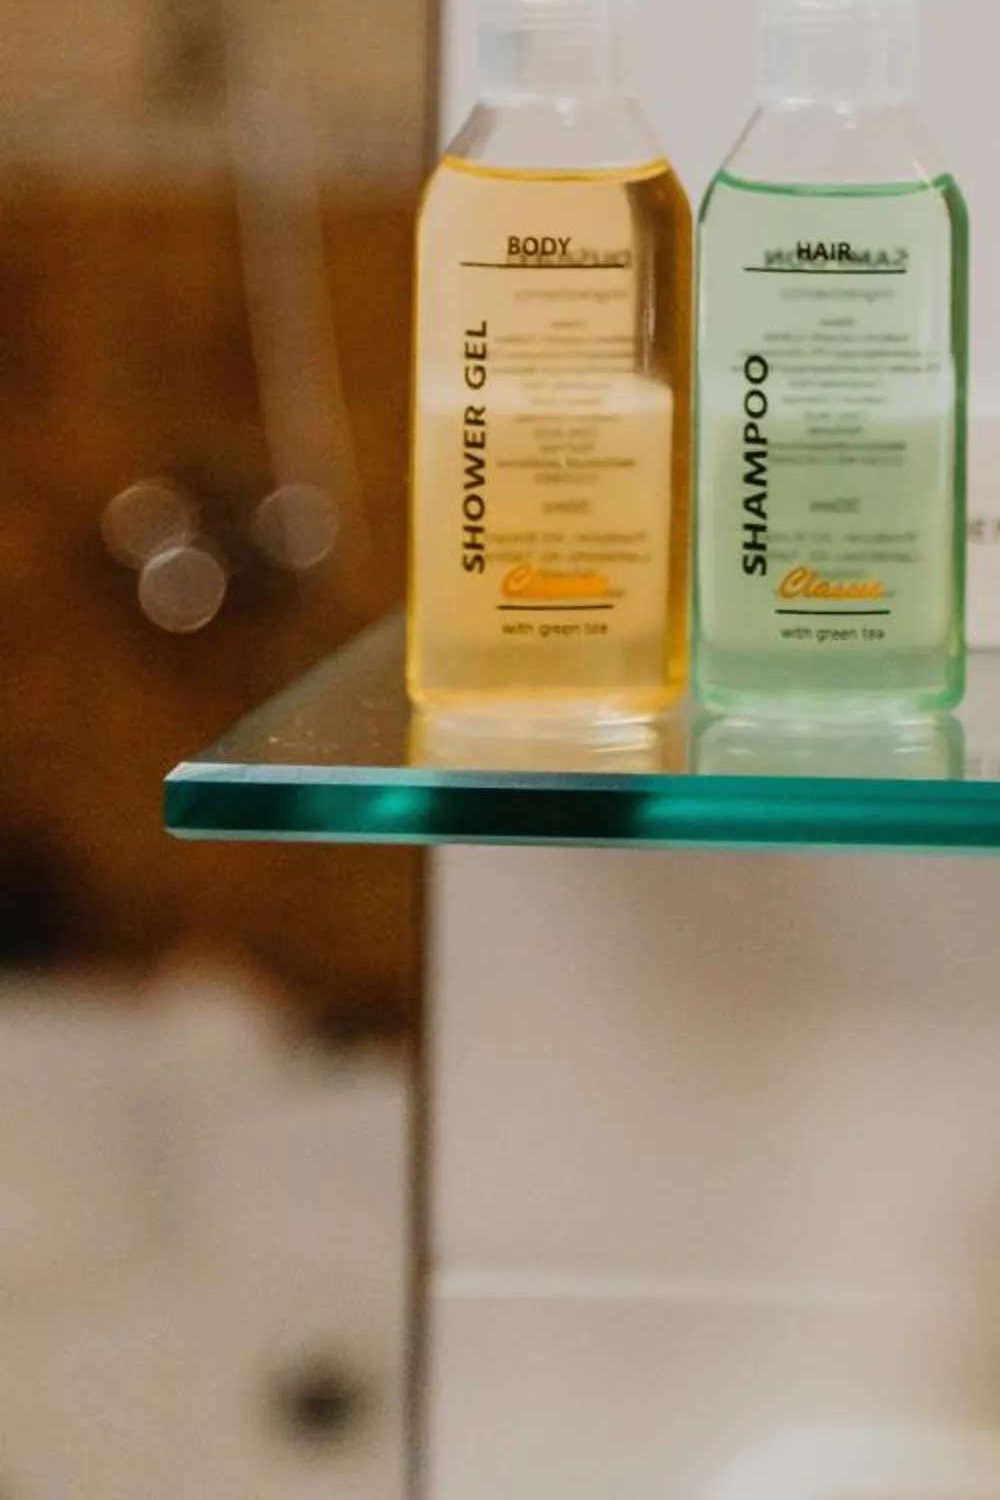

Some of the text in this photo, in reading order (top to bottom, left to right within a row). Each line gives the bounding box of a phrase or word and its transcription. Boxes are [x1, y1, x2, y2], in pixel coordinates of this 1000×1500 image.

[507, 235, 571, 257] BODY
[796, 242, 852, 261] HAIR
[462, 320, 488, 575] SHOWER GEL
[742, 355, 769, 577] SHAMPOO
[501, 622, 534, 635] with
[538, 623, 580, 638] green
[780, 627, 886, 643] with green tea
